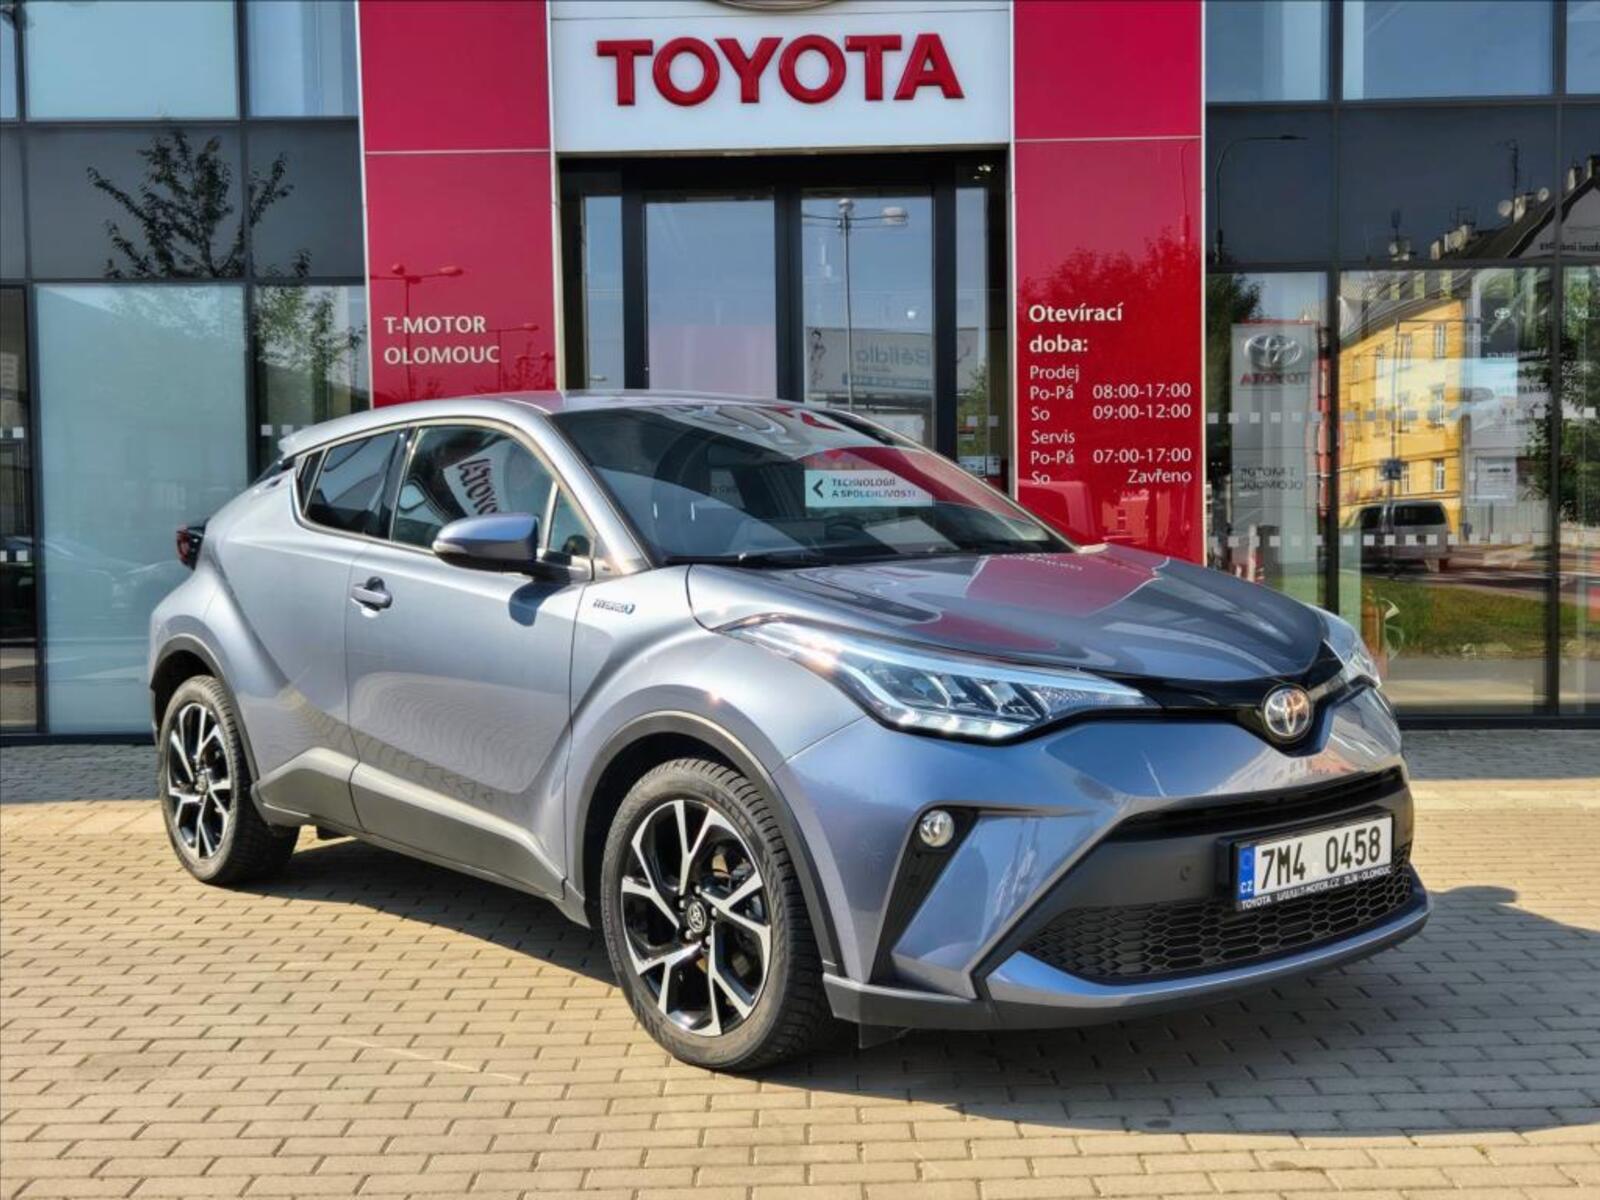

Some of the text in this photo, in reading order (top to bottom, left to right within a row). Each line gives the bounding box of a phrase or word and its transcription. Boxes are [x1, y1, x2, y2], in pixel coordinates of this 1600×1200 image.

[597, 34, 965, 106] TOYOTA
[1029, 302, 1124, 322] Otevírací
[383, 315, 486, 334] T-MOTOR
[1029, 334, 1089, 353] doba:
[384, 345, 500, 364] OLOMOUC
[1030, 364, 1080, 382] Prodej
[1030, 383, 1192, 400] Po-Pá 08:00-17:00
[1031, 403, 1192, 421] So 09:00-12:00
[1031, 429, 1076, 444] Servis
[1030, 447, 1192, 465] Po-Pá 07:00-17:00
[1031, 469, 1192, 486] So Zavřeno
[1261, 826, 1381, 890] 7M4 0458
[1240, 880, 1253, 894] CZ
[1241, 896, 1272, 910] TOYOTA
